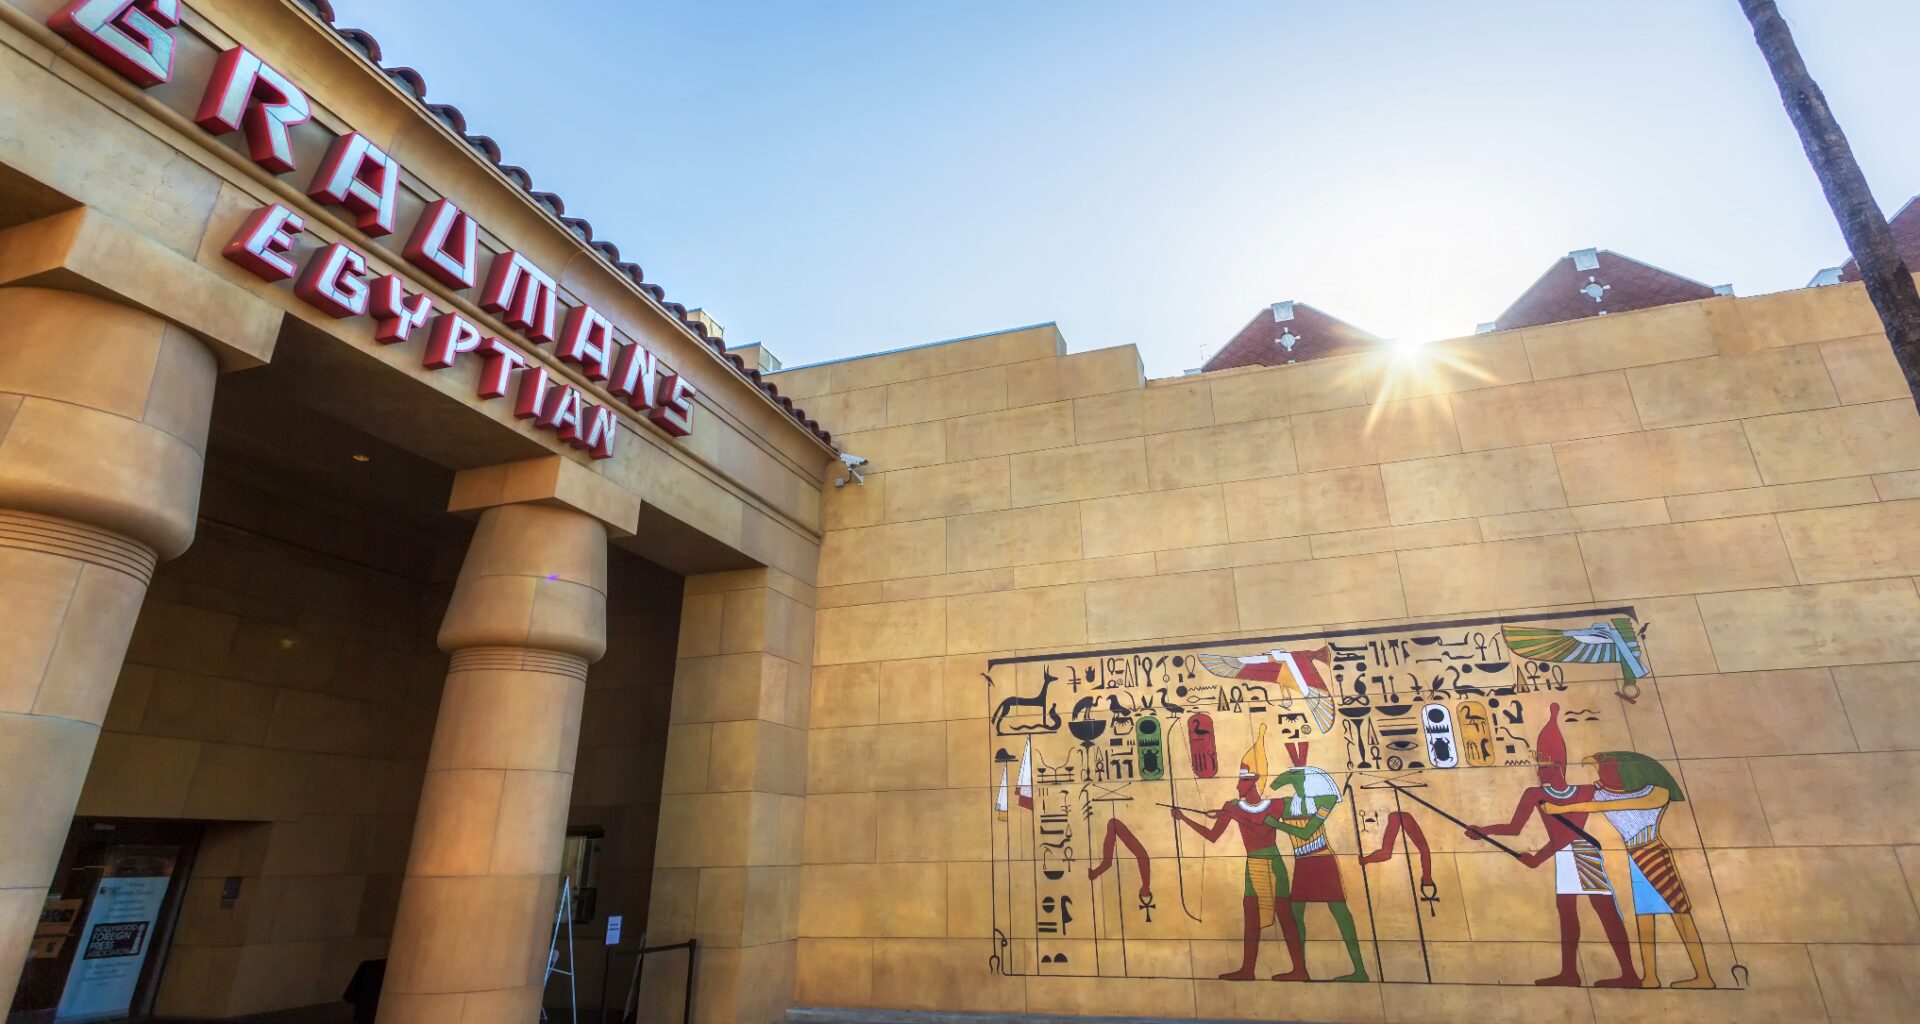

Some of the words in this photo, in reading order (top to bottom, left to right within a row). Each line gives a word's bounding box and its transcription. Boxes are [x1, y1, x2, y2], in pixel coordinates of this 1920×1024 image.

[222, 202, 619, 459] EGYPTIAN
[92, 932, 131, 941] FOREIGN
[89, 941, 114, 950] PRESS
